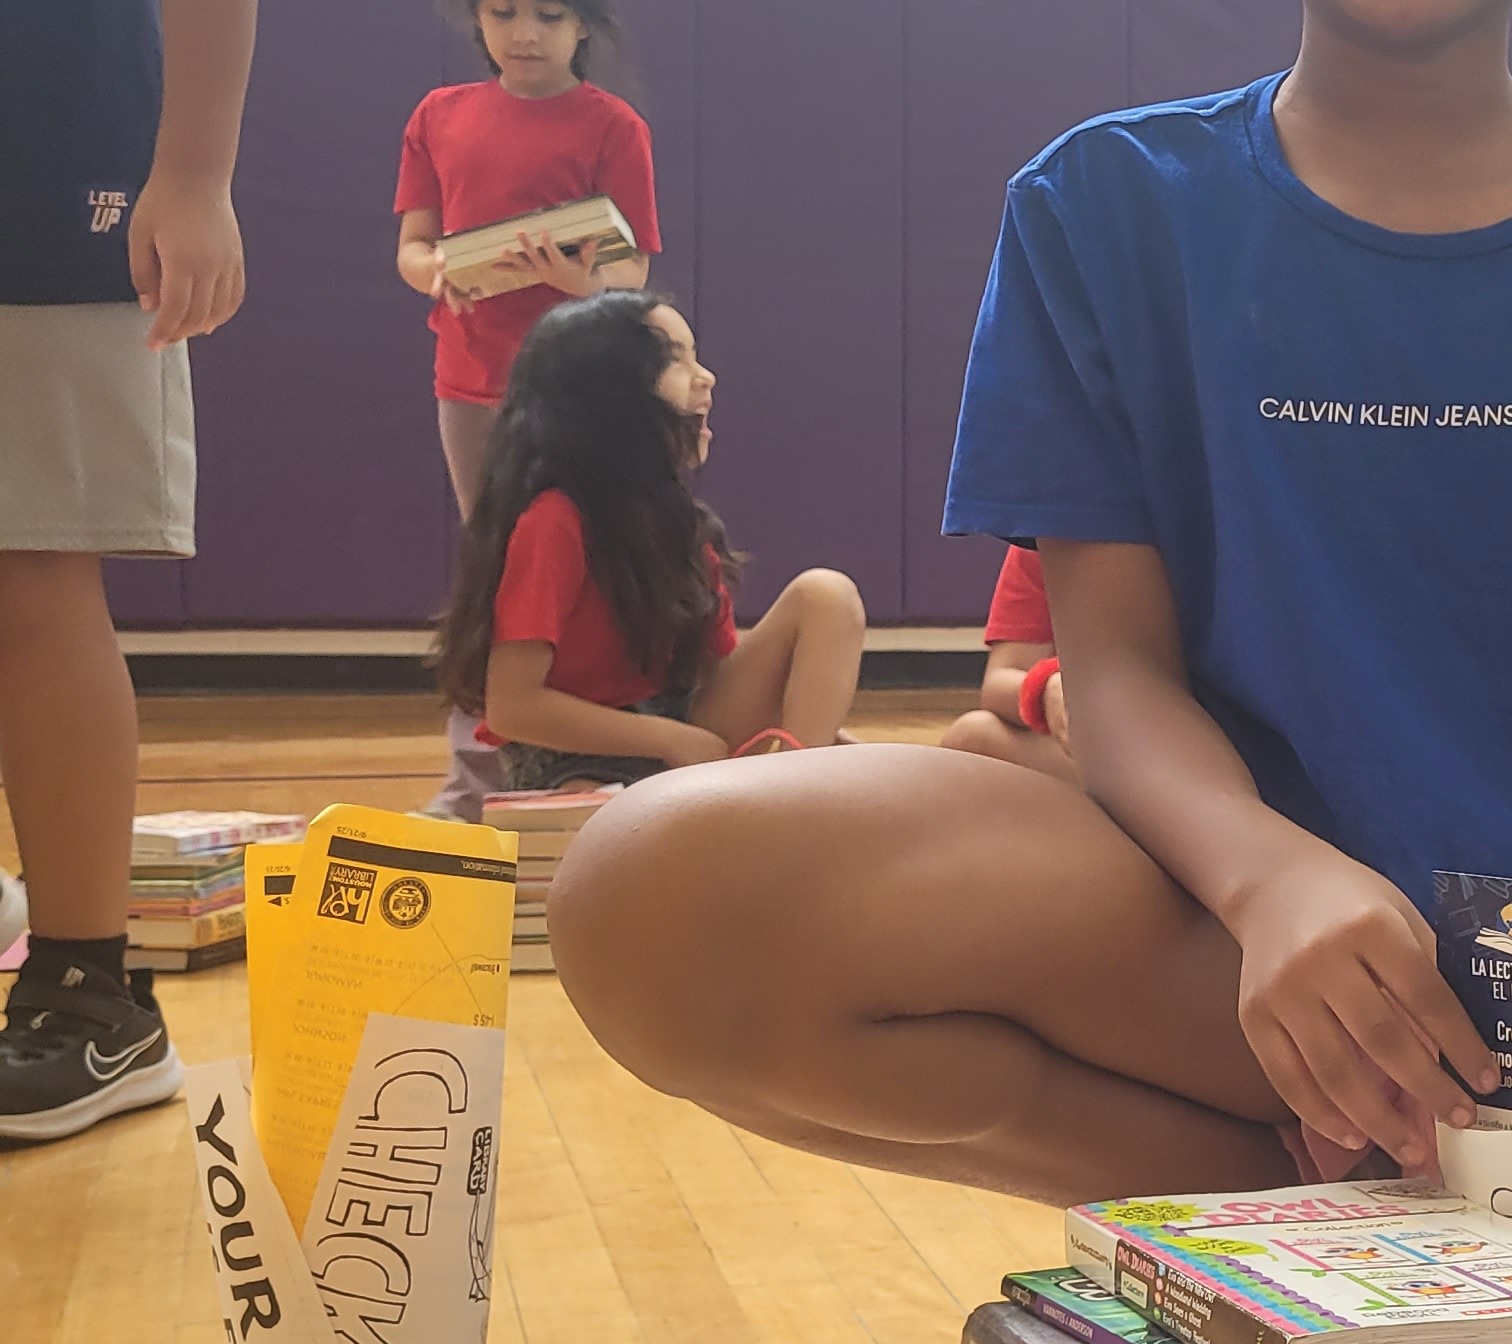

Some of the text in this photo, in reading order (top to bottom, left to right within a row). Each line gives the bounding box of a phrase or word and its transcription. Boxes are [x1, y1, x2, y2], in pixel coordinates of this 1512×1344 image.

[90, 206, 121, 233] UP
[1259, 397, 1353, 425] CALVIN
[1359, 403, 1429, 427] KLEIN
[332, 876, 372, 888] HOUSTON
[334, 866, 374, 882] LIBRARY
[1471, 957, 1487, 977] LA
[1493, 982, 1508, 1002] EL
[470, 1131, 485, 1191] CARD
[480, 1128, 493, 1191] LIBRARY
[1197, 1205, 1409, 1225] DIARIES
[1216, 1197, 1358, 1214] OWL
[195, 1093, 281, 1342] YOUR
[1117, 1245, 1131, 1267] OWL
[1131, 1252, 1156, 1280] DIARIES
